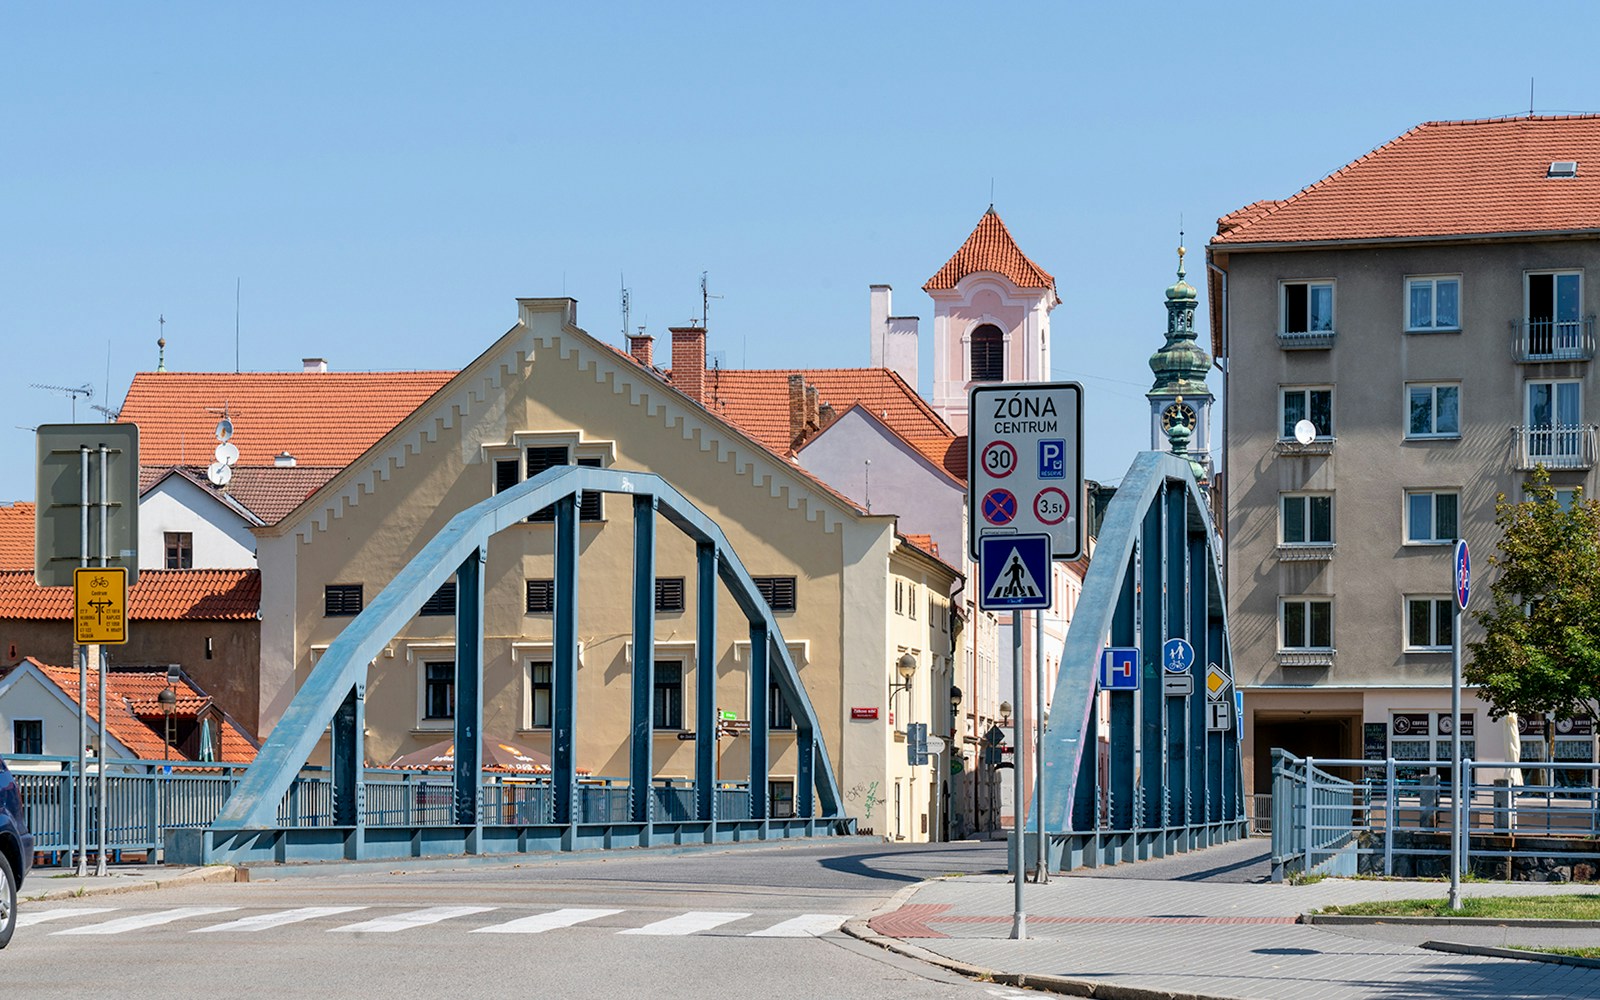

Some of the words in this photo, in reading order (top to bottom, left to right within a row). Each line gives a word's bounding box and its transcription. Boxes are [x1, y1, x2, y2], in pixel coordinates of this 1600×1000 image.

[994, 392, 1058, 418] ZÓNA
[994, 420, 1058, 434] CENTRUM
[988, 449, 1011, 469] 30
[1043, 444, 1060, 468] P
[1040, 499, 1063, 514] 3,5t
